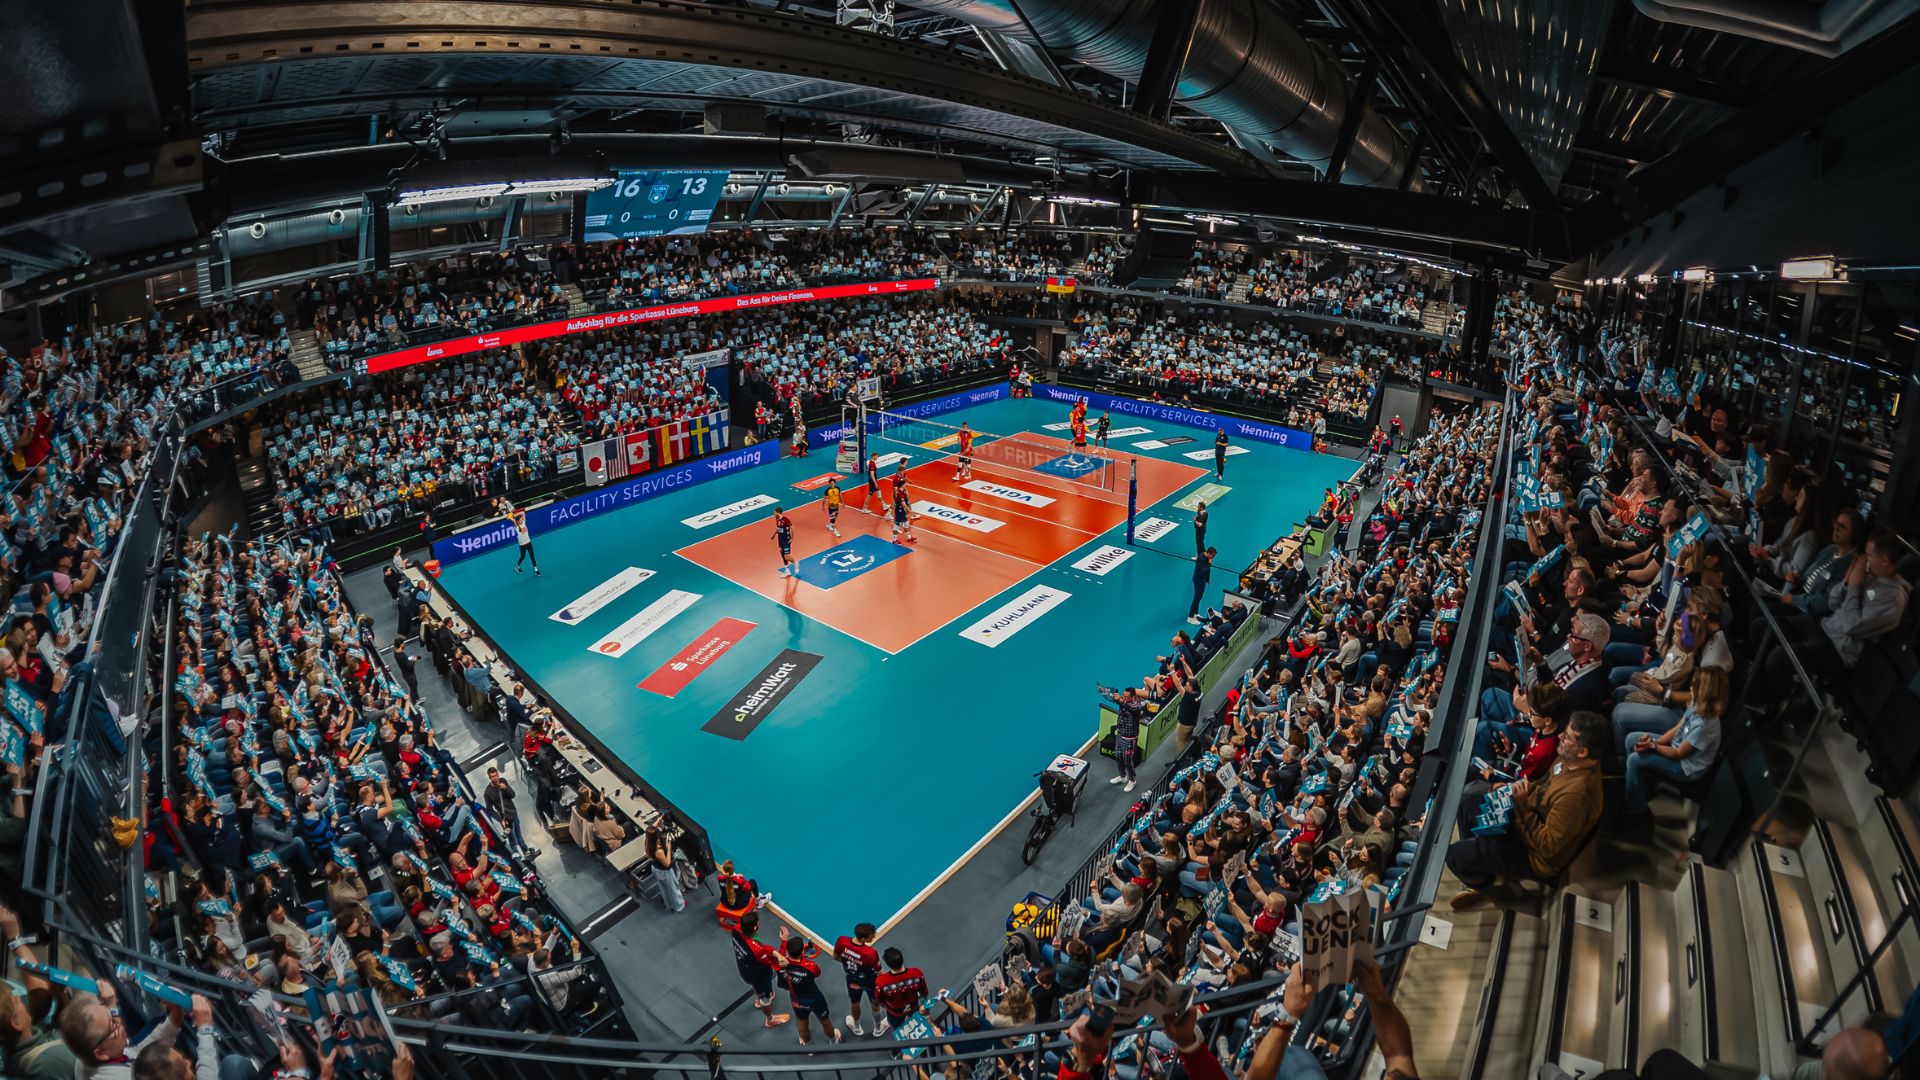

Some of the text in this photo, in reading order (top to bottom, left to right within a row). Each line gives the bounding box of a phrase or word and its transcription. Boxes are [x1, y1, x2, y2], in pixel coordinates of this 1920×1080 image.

[614, 179, 640, 198] 16
[682, 177, 707, 195] 13
[620, 211, 631, 223] 0
[668, 209, 679, 220] 0
[736, 299, 749, 307] Das
[750, 297, 761, 305] Ass
[771, 294, 788, 302] Deine
[566, 305, 700, 332] Aufschlag für die Sparkasse Lüneburg.
[969, 388, 999, 403] Henning
[1047, 388, 1089, 405] Henning
[878, 397, 961, 426] FACILITY SERVICES
[1110, 400, 1216, 428] FACILITY SERVICES
[1236, 422, 1288, 445] Henning
[707, 450, 761, 473] Henning
[550, 469, 692, 524] FACILITY SERVICES
[720, 494, 765, 516] CLAGE
[992, 488, 1032, 502] VGH
[927, 506, 969, 522] VGH
[452, 525, 518, 553] Hennin
[1135, 519, 1171, 539] willke
[831, 553, 863, 567] LZ
[1084, 548, 1126, 572] willke
[686, 636, 721, 663] Sparkasse
[696, 640, 731, 665] Lüneburg
[734, 662, 797, 714] heimWatt
[1779, 855, 1791, 866] 3
[1303, 906, 1360, 936] ROCK
[1589, 908, 1599, 919] 2
[899, 1018, 918, 1036] MEIN
